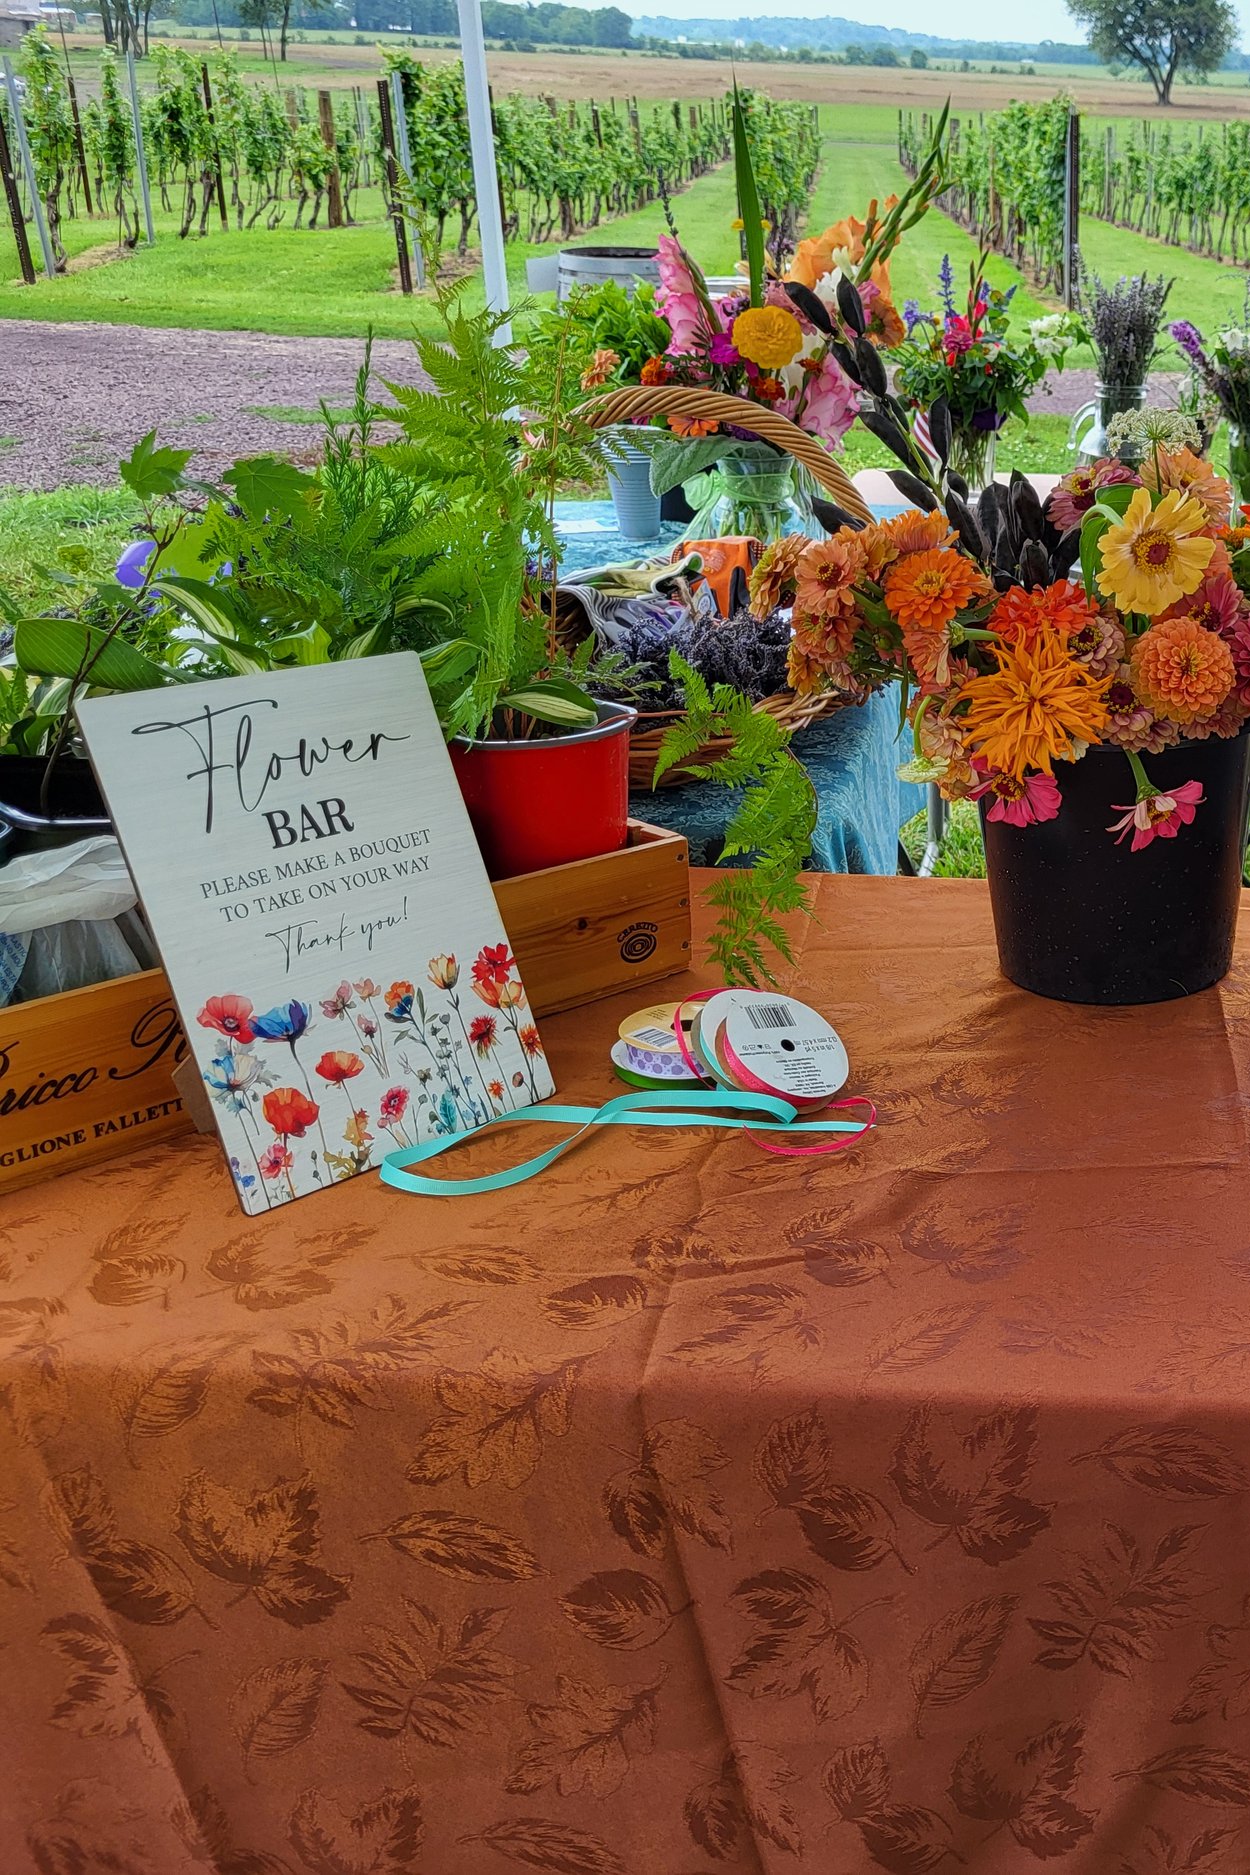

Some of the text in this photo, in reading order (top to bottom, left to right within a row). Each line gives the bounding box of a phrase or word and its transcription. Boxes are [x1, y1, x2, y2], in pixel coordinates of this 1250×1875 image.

[131, 699, 411, 834] Flower
[262, 797, 355, 849] BAR
[200, 829, 432, 899] PLEASE MAKE A BOUQUET
[219, 855, 431, 923] TO TAKE ON YOUR WAY
[265, 895, 408, 974] Thank you!
